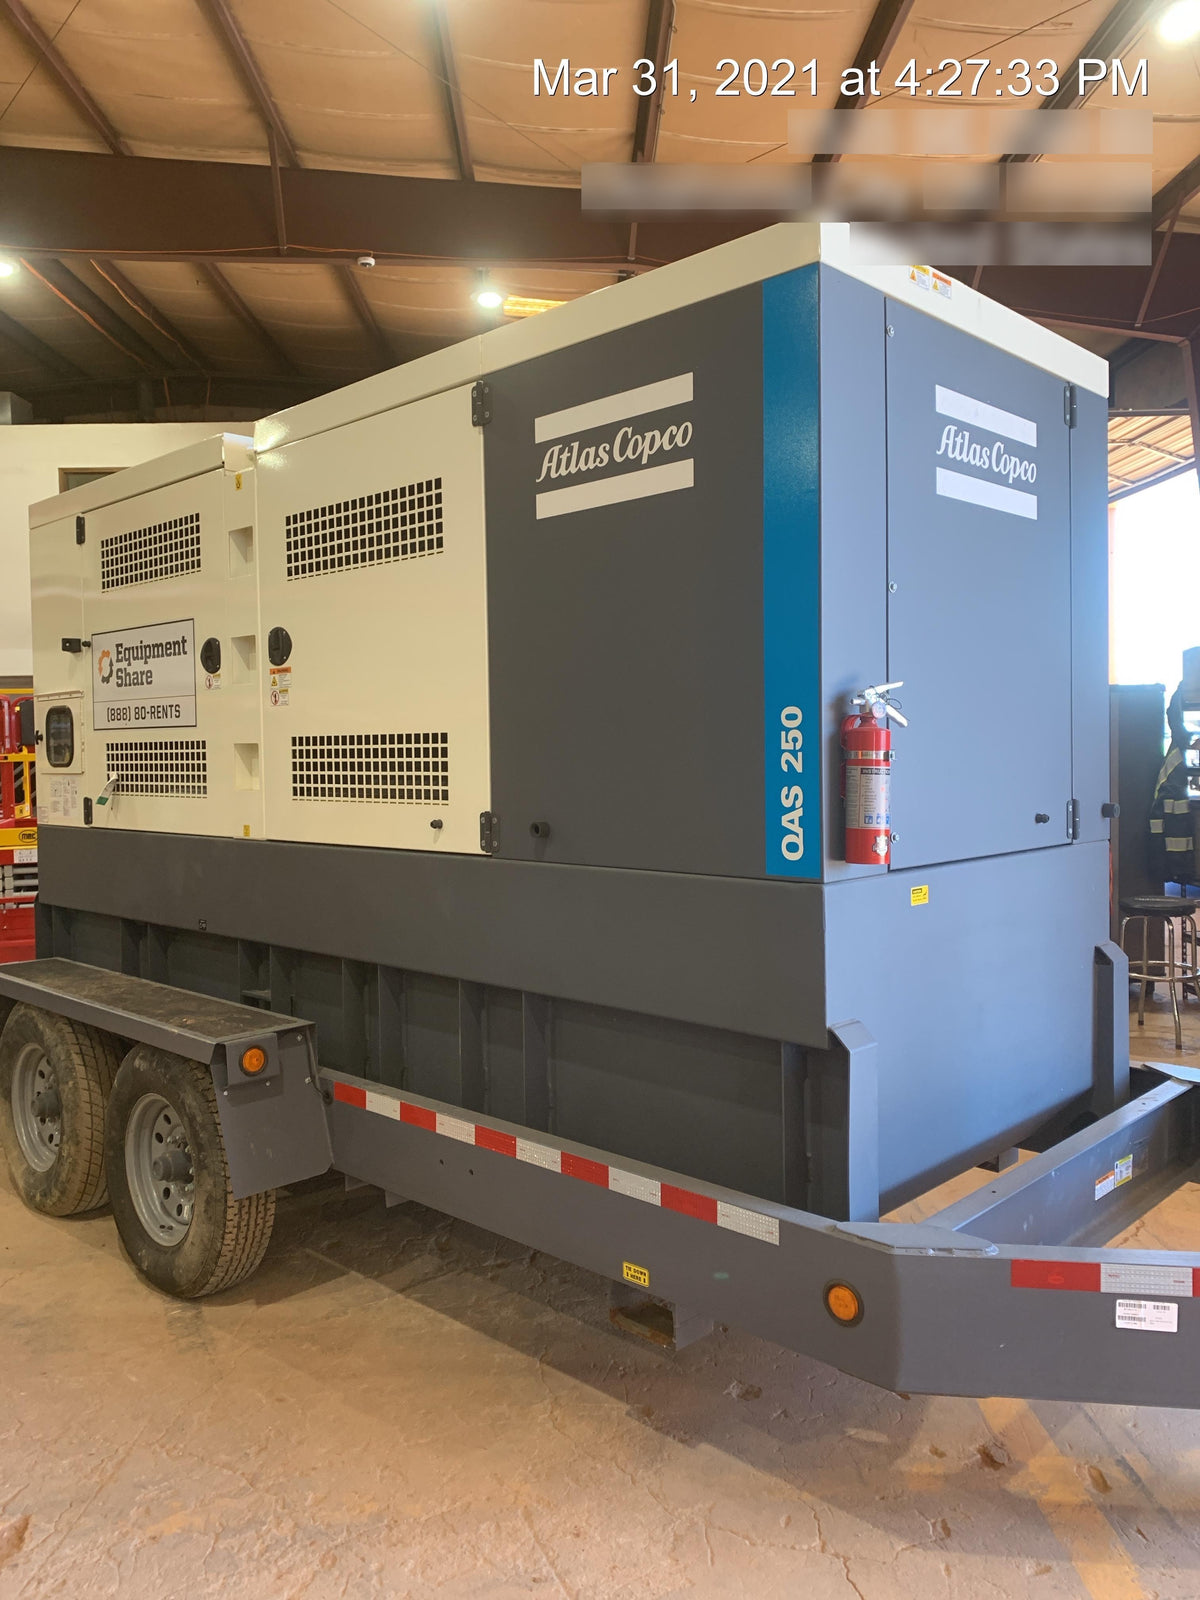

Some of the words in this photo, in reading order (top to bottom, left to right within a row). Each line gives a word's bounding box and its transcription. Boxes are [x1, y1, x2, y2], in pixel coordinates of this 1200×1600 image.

[536, 441, 610, 483] Atlas
[613, 421, 693, 465] Copco
[936, 424, 990, 469] Atlas
[991, 441, 1037, 484] Copco
[115, 635, 187, 666] Equipment
[116, 667, 153, 688] Share
[107, 706, 131, 722] (888)
[134, 704, 181, 720] 80-RENTS
[780, 705, 803, 773] 250
[781, 785, 804, 861] QAS
